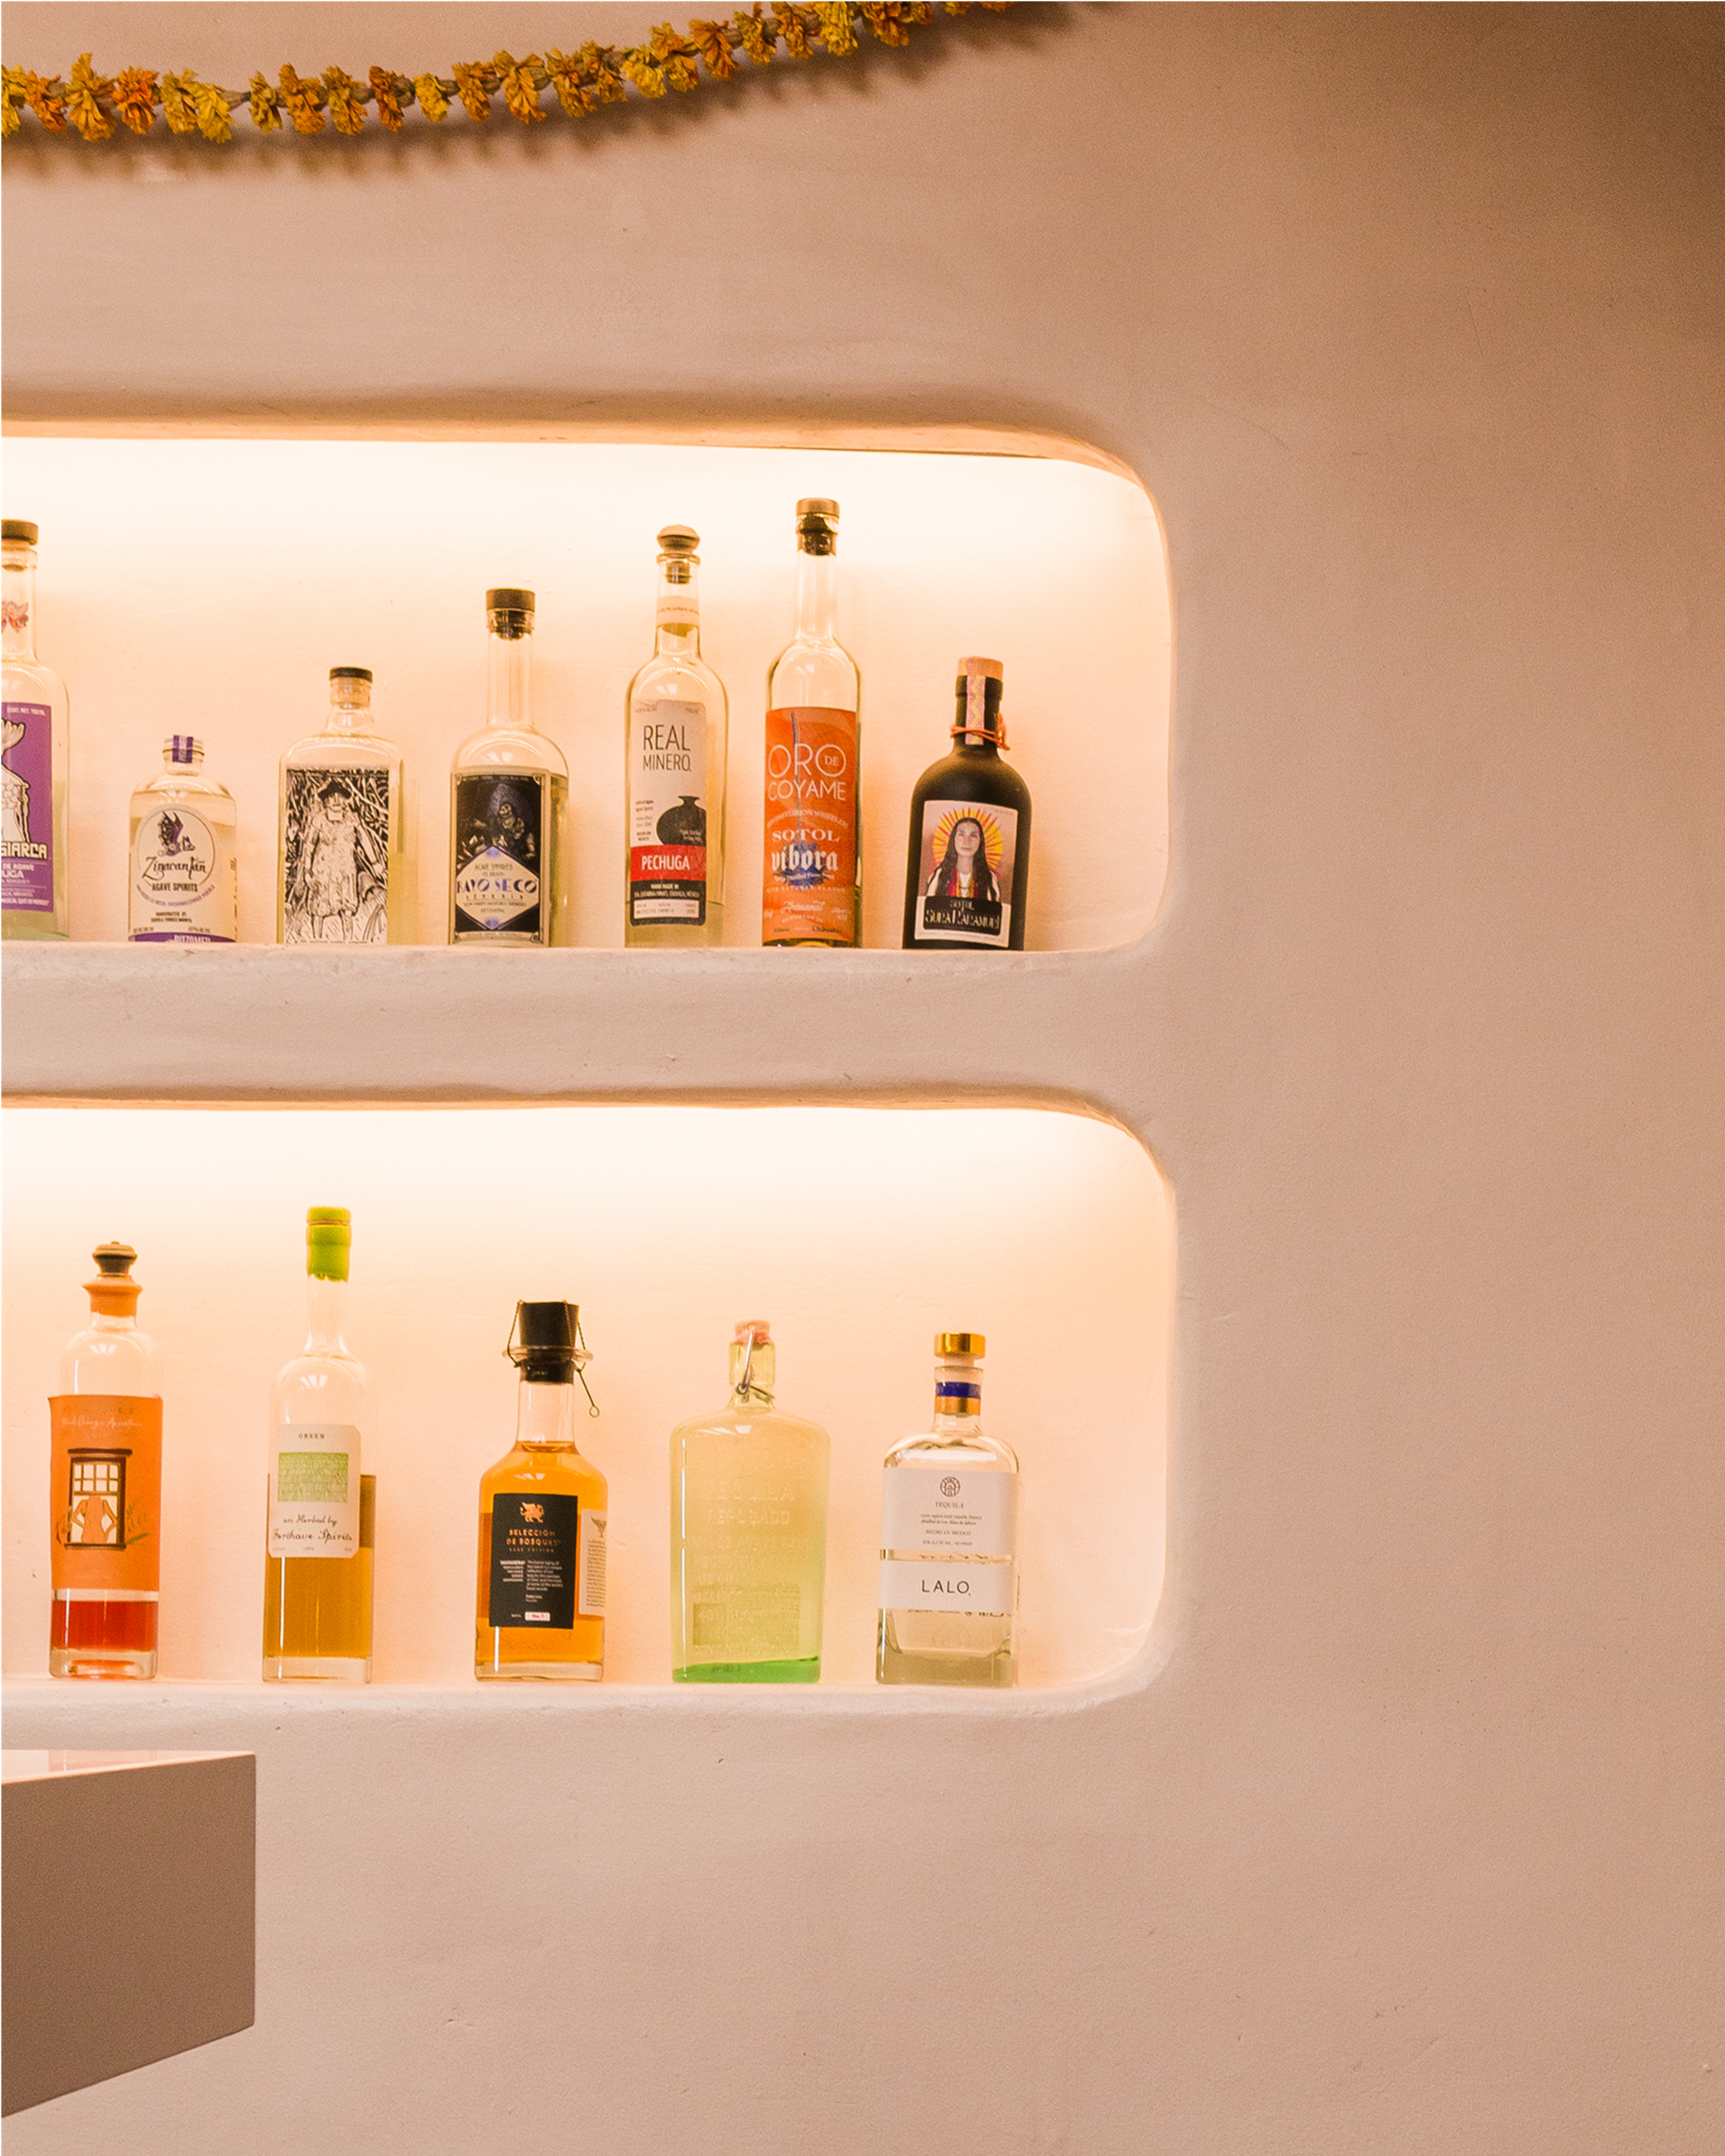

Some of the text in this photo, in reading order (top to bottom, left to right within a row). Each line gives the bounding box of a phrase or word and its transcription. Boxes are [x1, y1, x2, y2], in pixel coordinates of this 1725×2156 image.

[643, 725, 690, 751] REAL
[768, 743, 847, 778] ORO
[824, 755, 838, 765] DE
[768, 779, 846, 801] COYAME
[772, 829, 840, 842] SOTOL
[641, 855, 691, 870] PECHUGA
[152, 884, 198, 892] AGAVE SPIRITS
[327, 1515, 338, 1528] by
